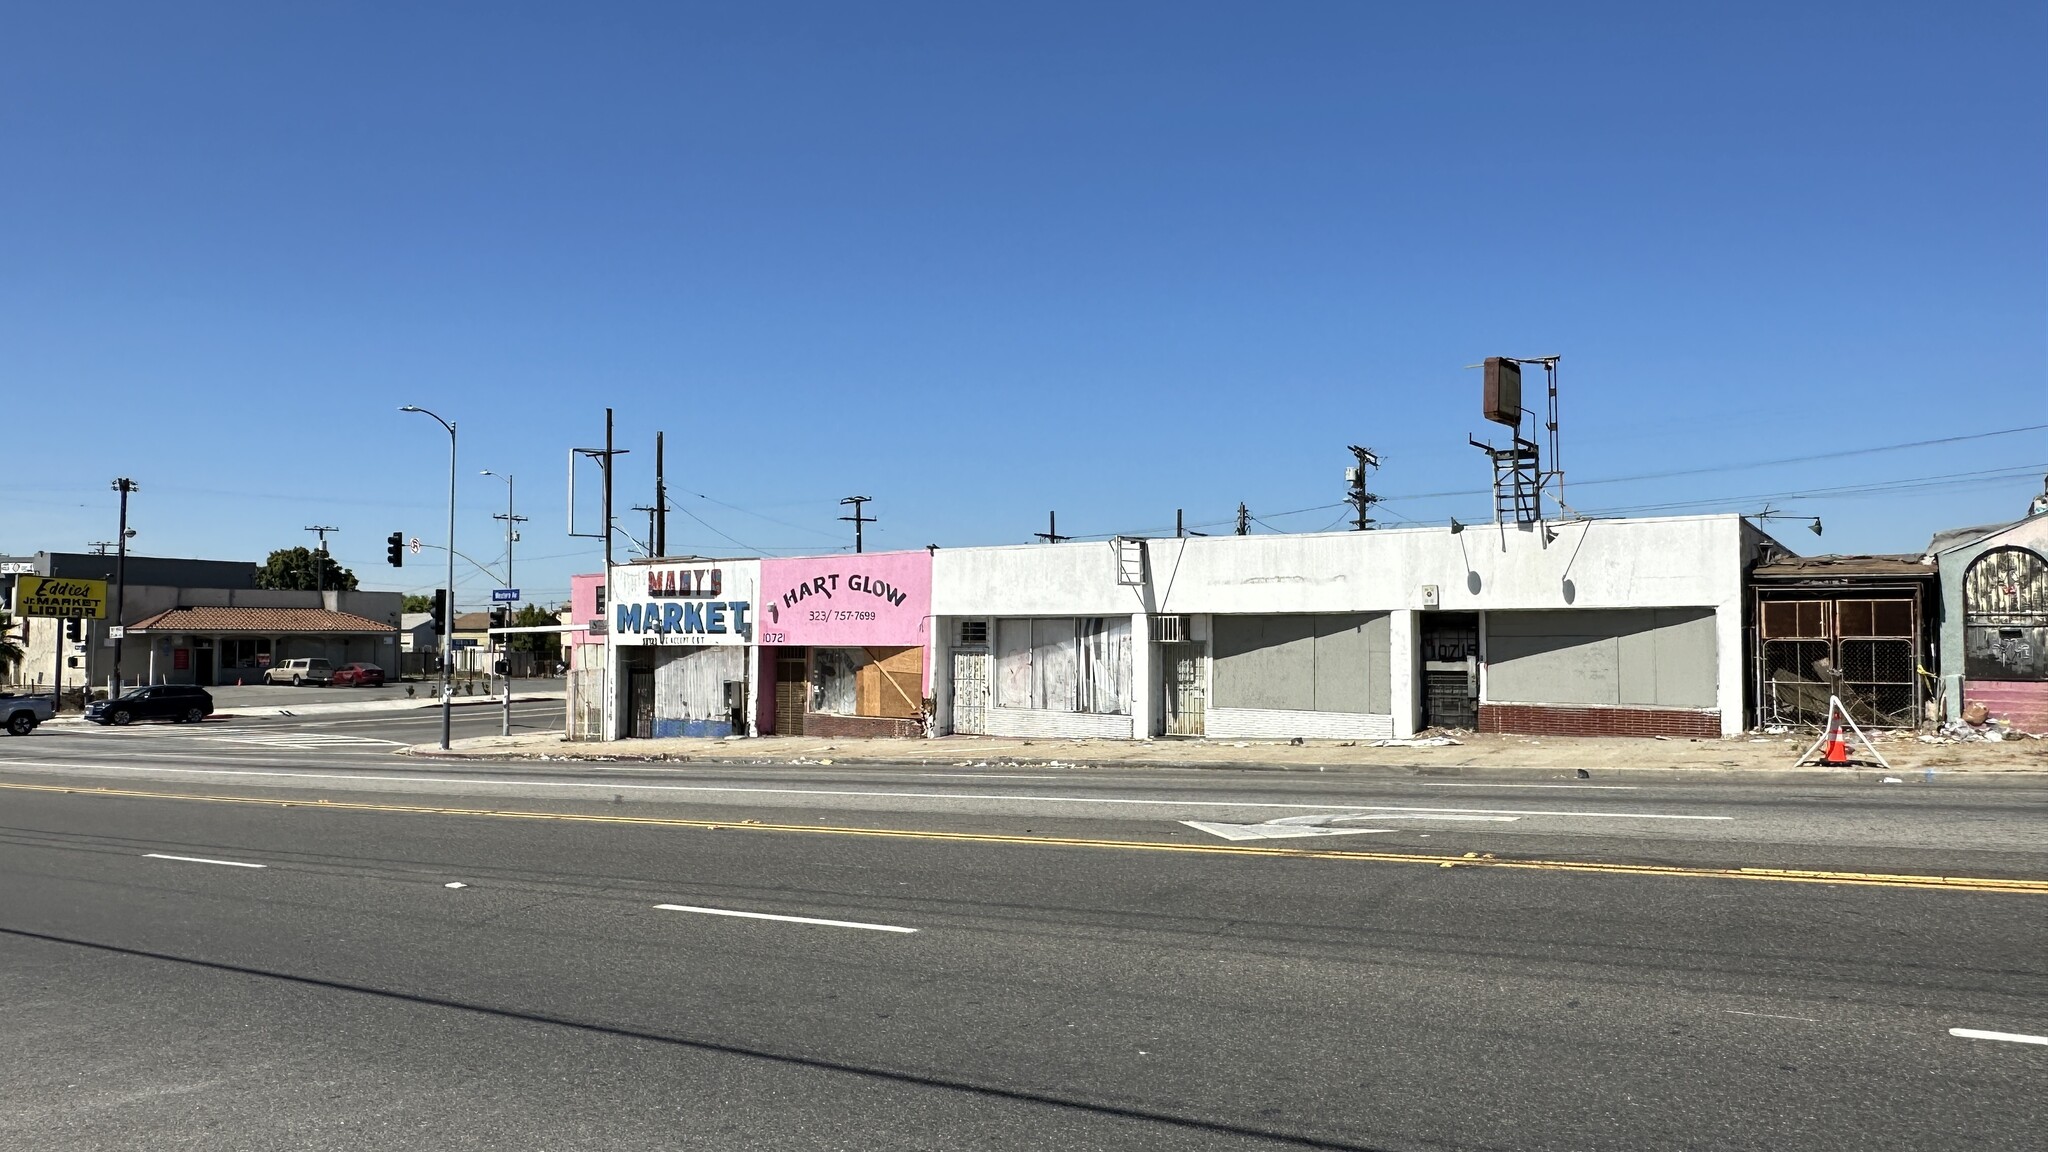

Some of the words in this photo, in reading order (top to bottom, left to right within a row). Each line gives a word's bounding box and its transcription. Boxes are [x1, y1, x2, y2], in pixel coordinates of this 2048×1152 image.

[35, 579, 91, 598] Eddie's
[648, 569, 722, 596] MAY'S
[782, 574, 840, 609] HART
[848, 574, 907, 607] GLOW
[37, 597, 101, 607] MARKET
[28, 605, 97, 617] LIQUOR
[617, 601, 749, 634] MARKET
[834, 611, 876, 621] 757-7699
[763, 633, 786, 643] 10721
